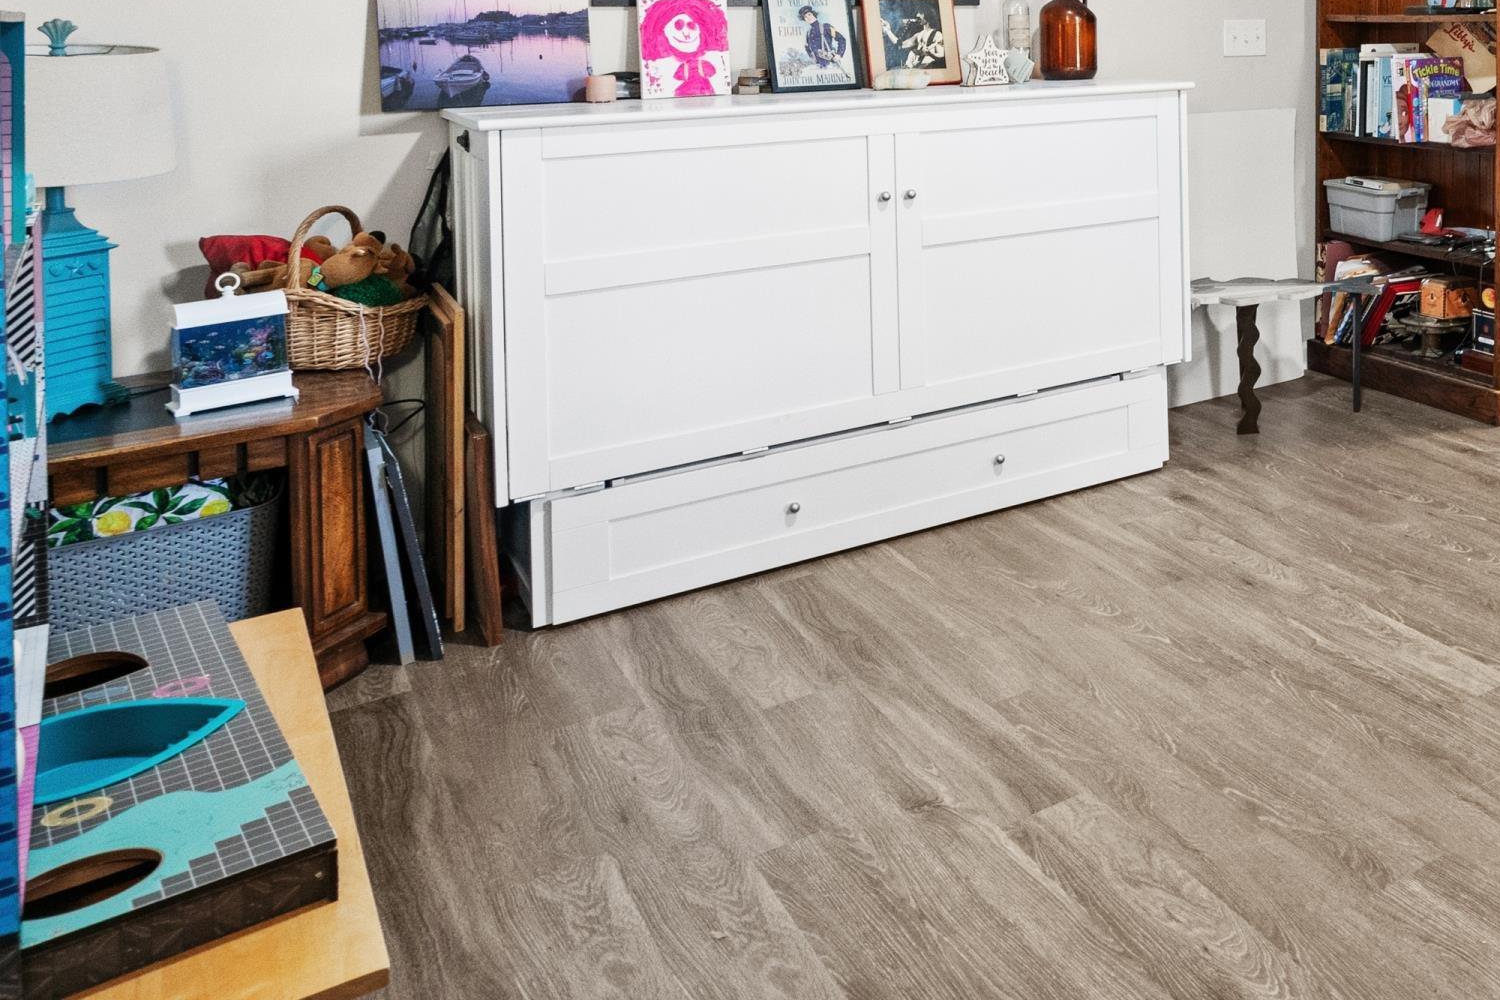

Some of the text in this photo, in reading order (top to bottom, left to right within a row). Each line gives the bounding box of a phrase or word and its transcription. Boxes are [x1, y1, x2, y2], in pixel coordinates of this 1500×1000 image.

[789, 0, 801, 7] YOU
[1413, 63, 1460, 78] Tickle Time
